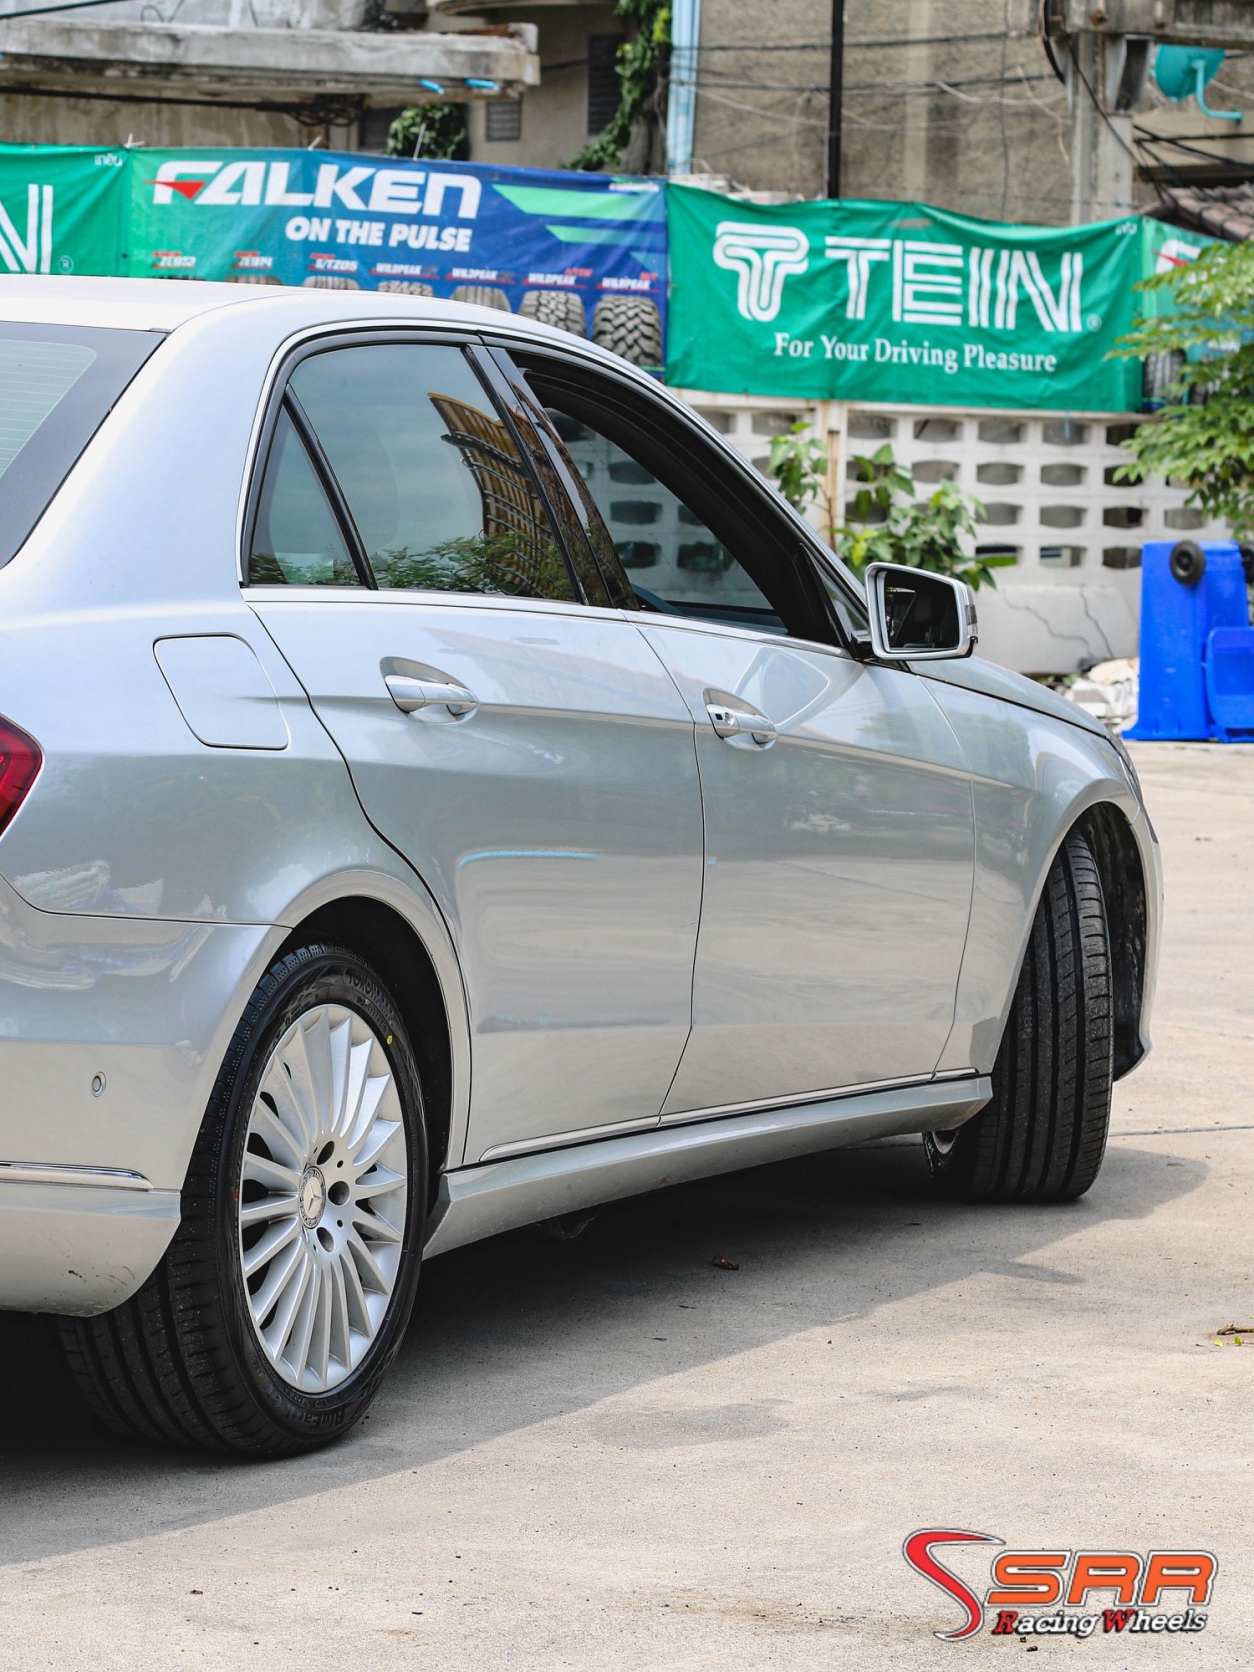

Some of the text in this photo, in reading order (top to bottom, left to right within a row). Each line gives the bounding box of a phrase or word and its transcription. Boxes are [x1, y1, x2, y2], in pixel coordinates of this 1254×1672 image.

[148, 160, 482, 219] FALKEN
[286, 216, 473, 253] ON THE PULSE
[375, 262, 423, 276] WILDPEAK
[451, 267, 499, 281] WILDPEAK
[527, 272, 577, 286] WILDPEAK
[601, 277, 652, 291] WILDPEAK
[825, 235, 1084, 333] TEIN
[773, 332, 1057, 375] For Your Driving Pleasure
